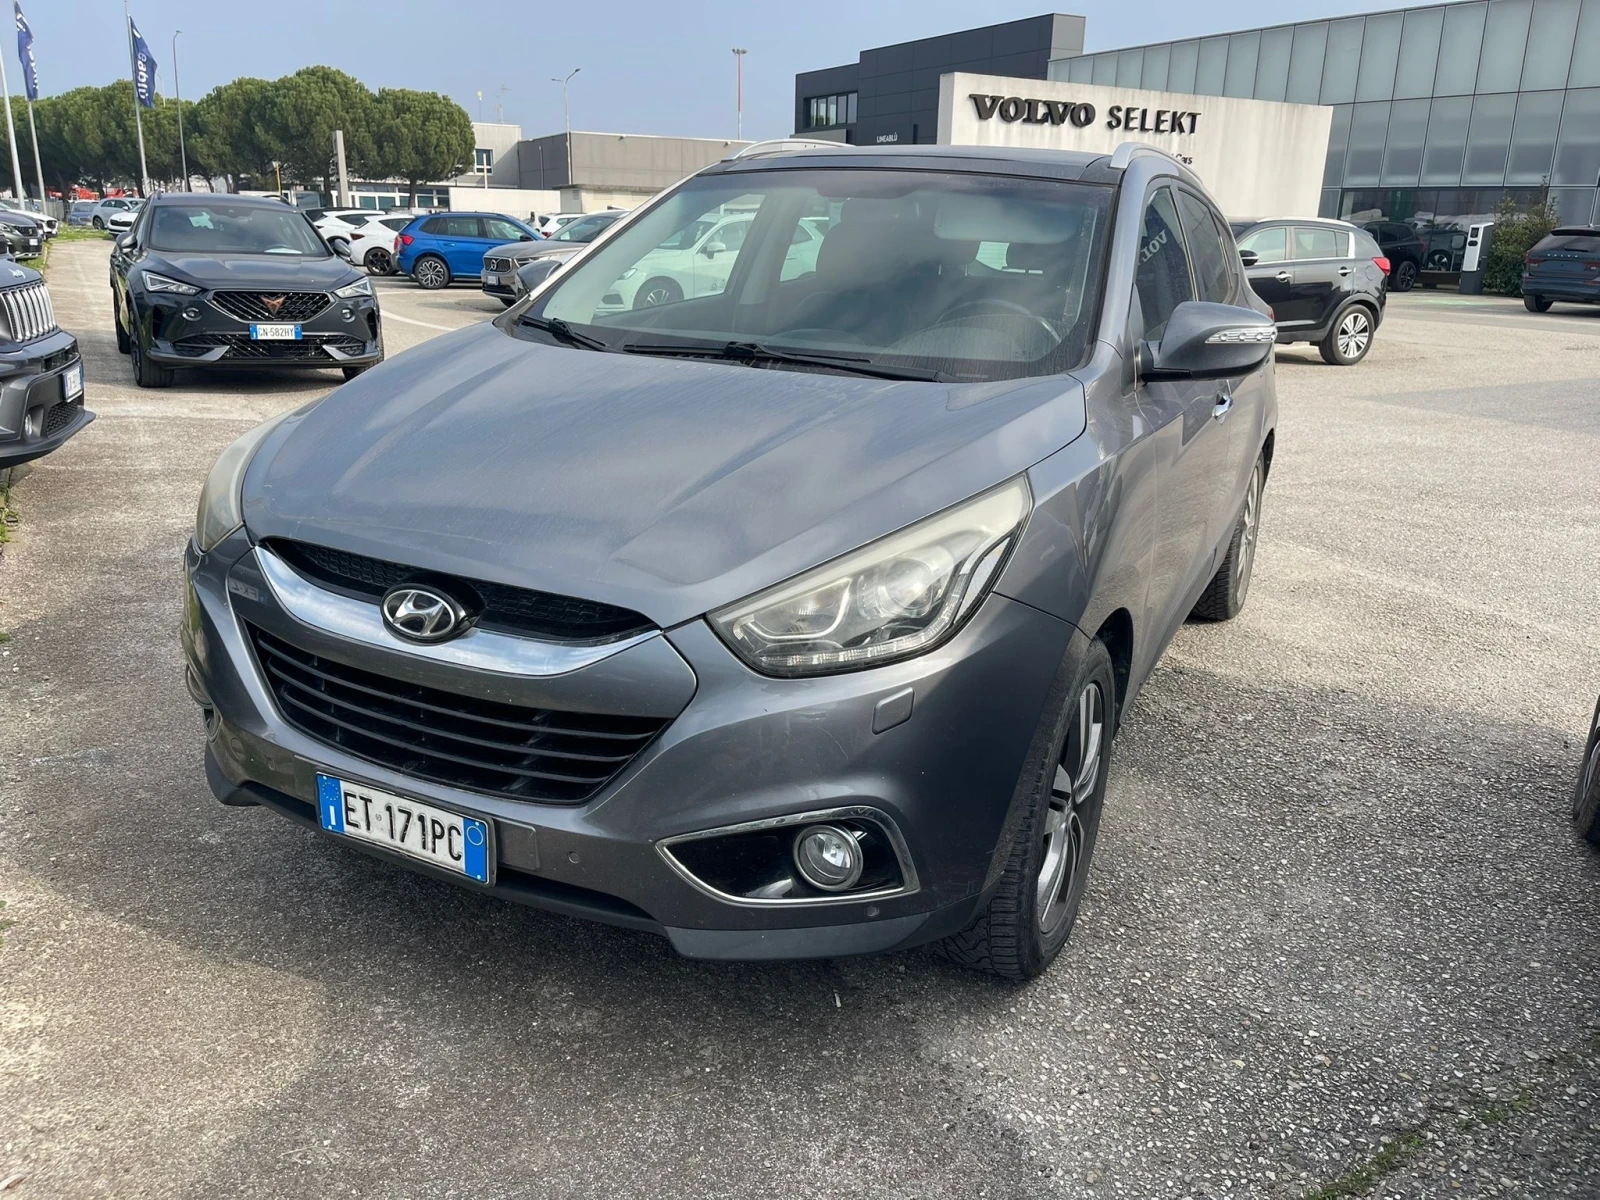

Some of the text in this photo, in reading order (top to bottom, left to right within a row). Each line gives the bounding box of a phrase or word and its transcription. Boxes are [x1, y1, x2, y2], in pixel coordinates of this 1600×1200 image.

[969, 93, 1202, 135] VOLVO SELEKT
[343, 791, 372, 831] ET
[385, 804, 462, 861] 171PC
